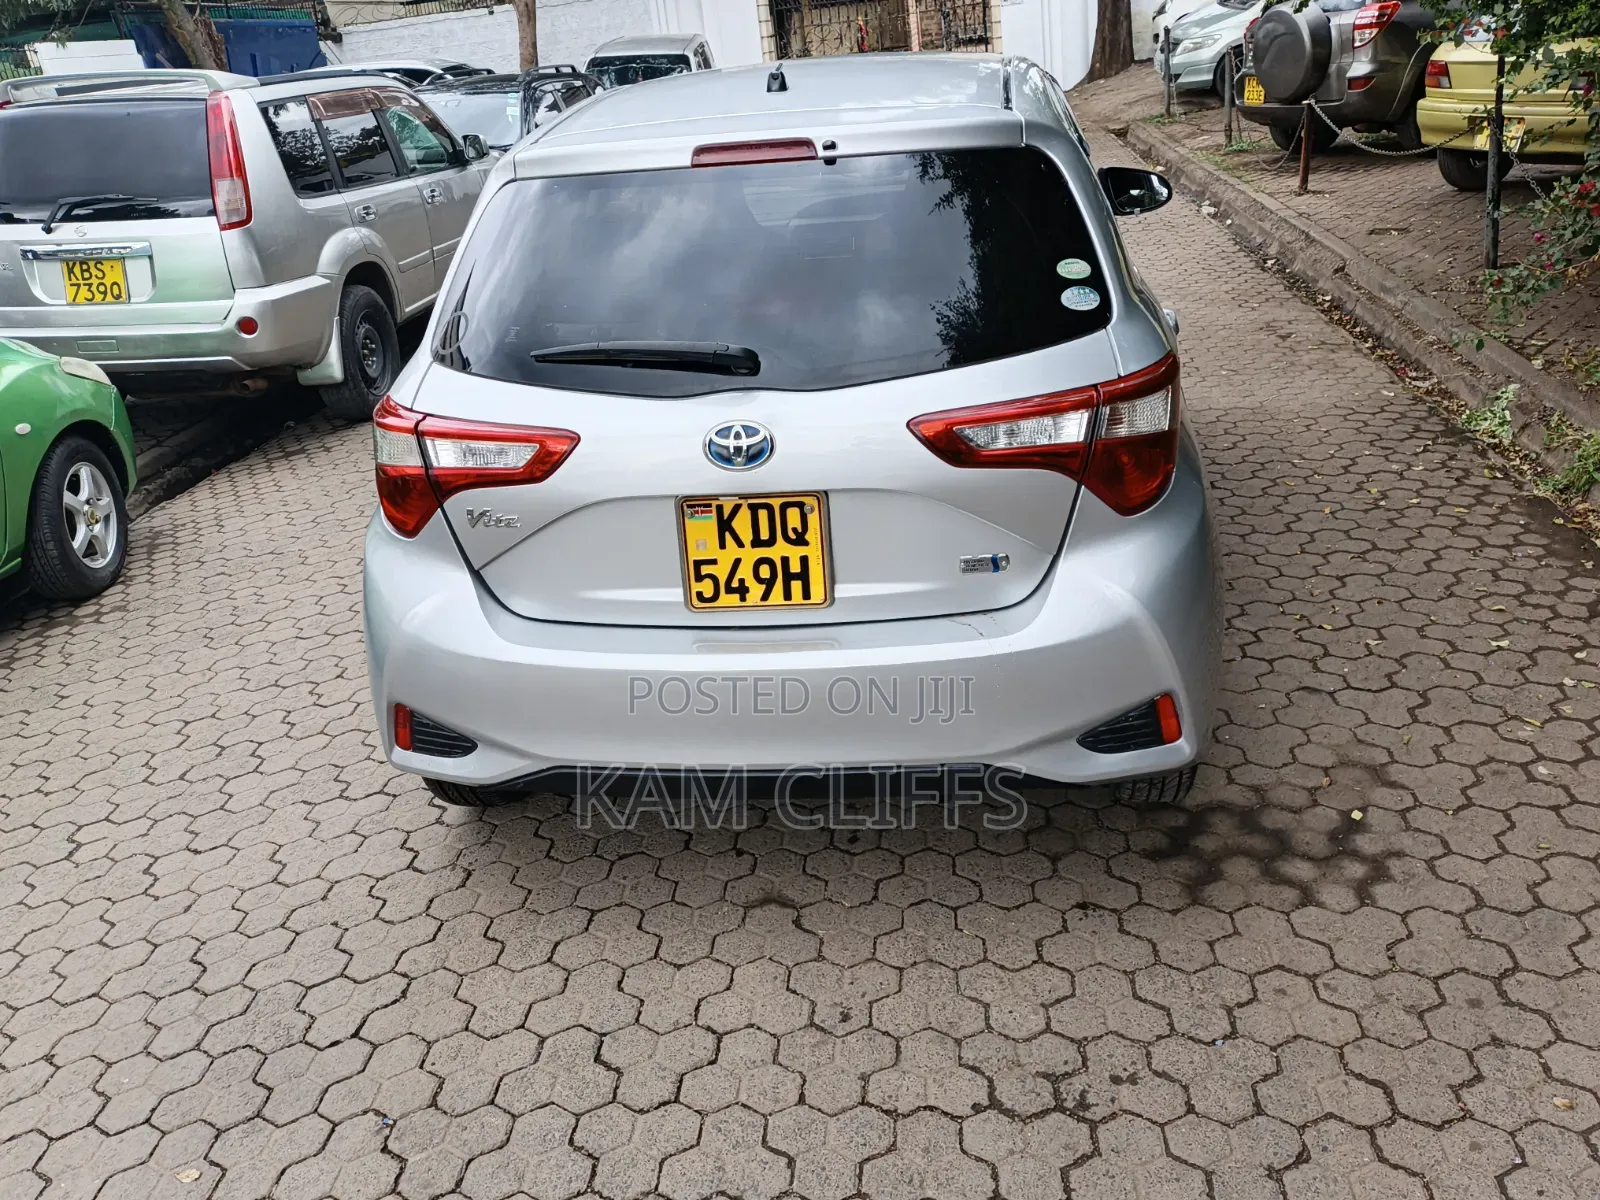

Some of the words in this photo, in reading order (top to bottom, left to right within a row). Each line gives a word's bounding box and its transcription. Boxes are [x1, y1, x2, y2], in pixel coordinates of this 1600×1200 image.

[1246, 90, 1263, 101] 233E
[66, 260, 106, 282] KBS
[69, 281, 124, 303] 739Q
[466, 507, 522, 529] Vitz
[715, 501, 810, 550] KDQ
[692, 555, 812, 604] 549H
